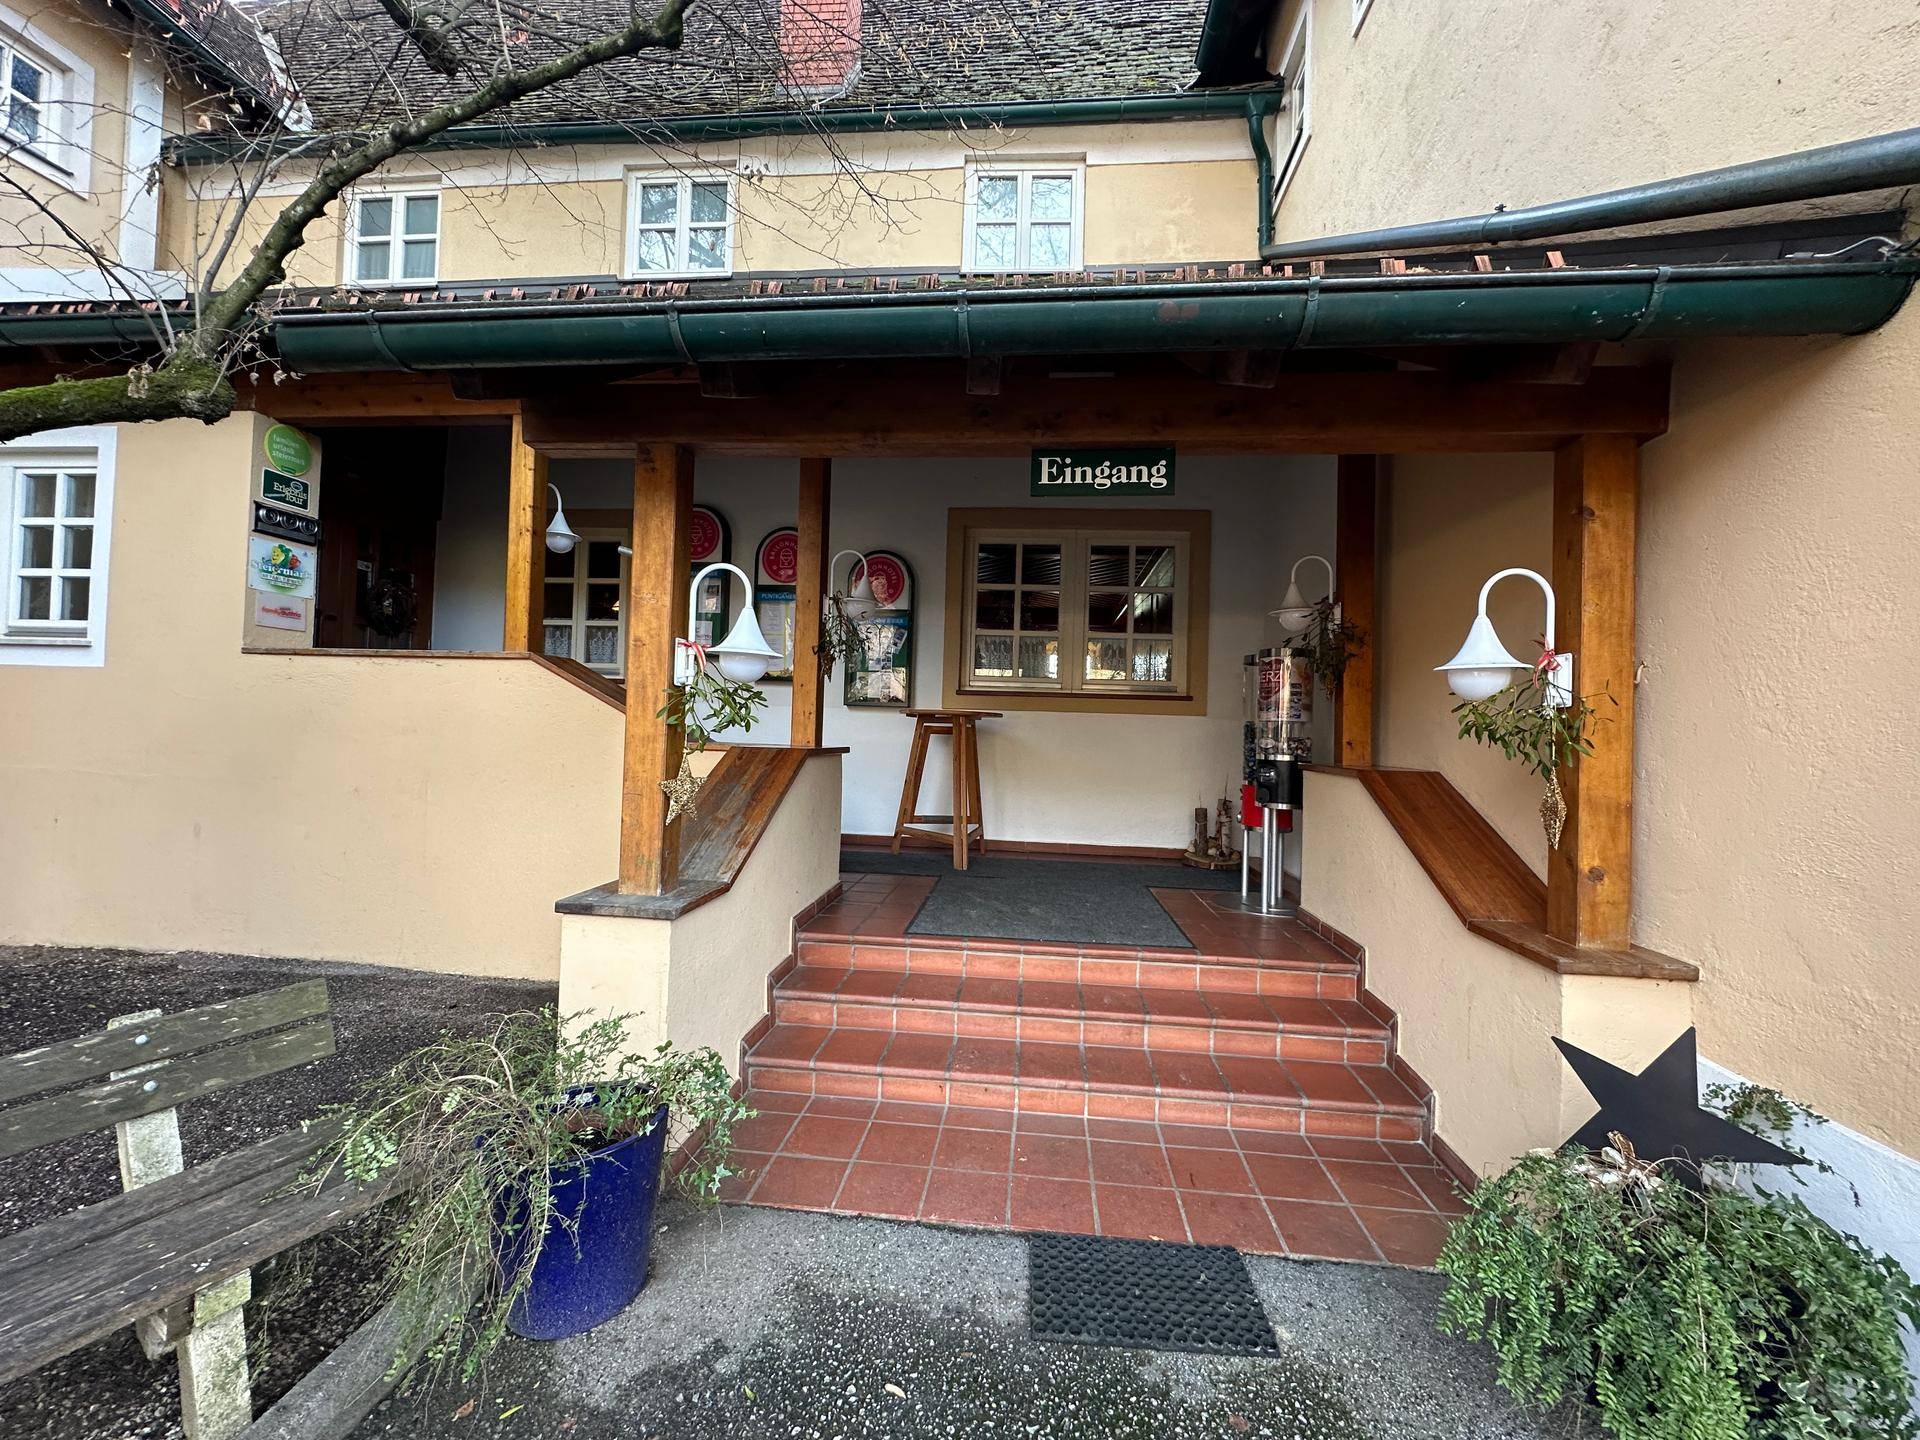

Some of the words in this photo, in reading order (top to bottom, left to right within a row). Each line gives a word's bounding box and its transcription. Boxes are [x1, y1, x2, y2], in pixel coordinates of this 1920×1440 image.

[1038, 457, 1168, 489] Eingang
[273, 482, 308, 500] Erlebnis
[285, 492, 304, 505] Tour
[251, 560, 312, 579] Steiermark
